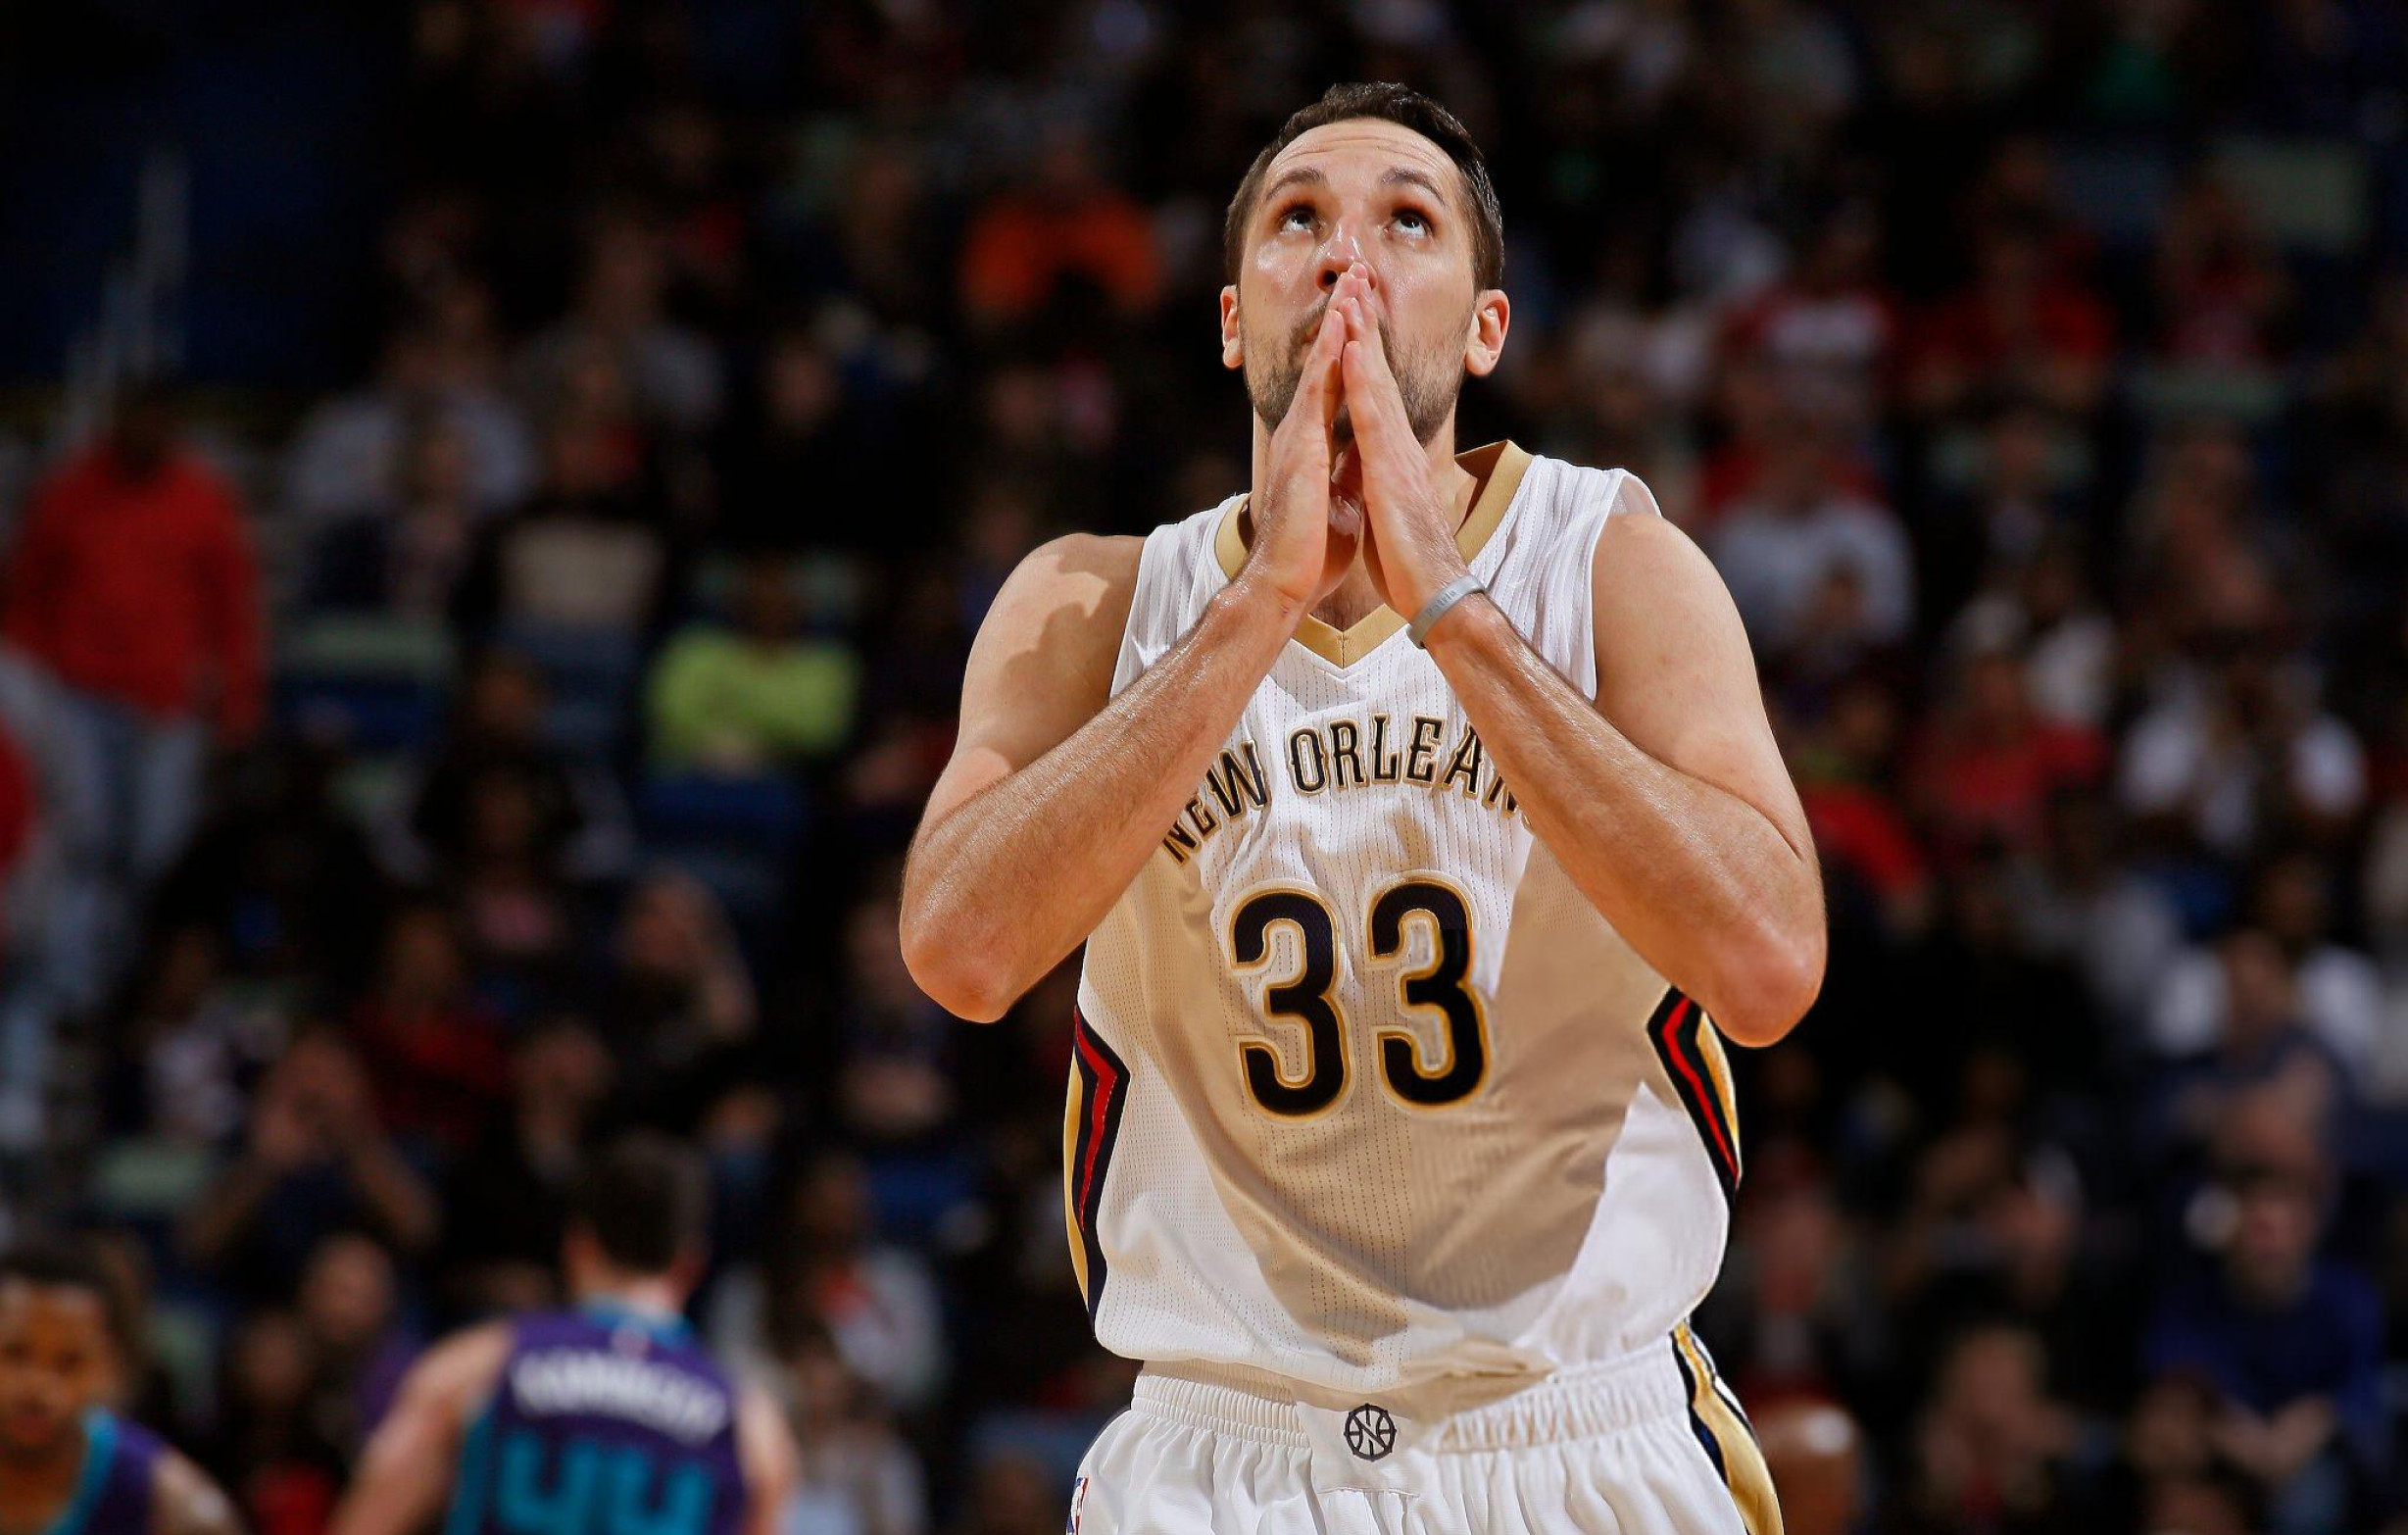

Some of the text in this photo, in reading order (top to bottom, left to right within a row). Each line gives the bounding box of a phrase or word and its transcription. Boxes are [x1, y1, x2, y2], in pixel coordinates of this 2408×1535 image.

[1287, 714, 1526, 821] ORLEA
[1229, 876, 1489, 1118] 33
[496, 1435, 713, 1535] 44
